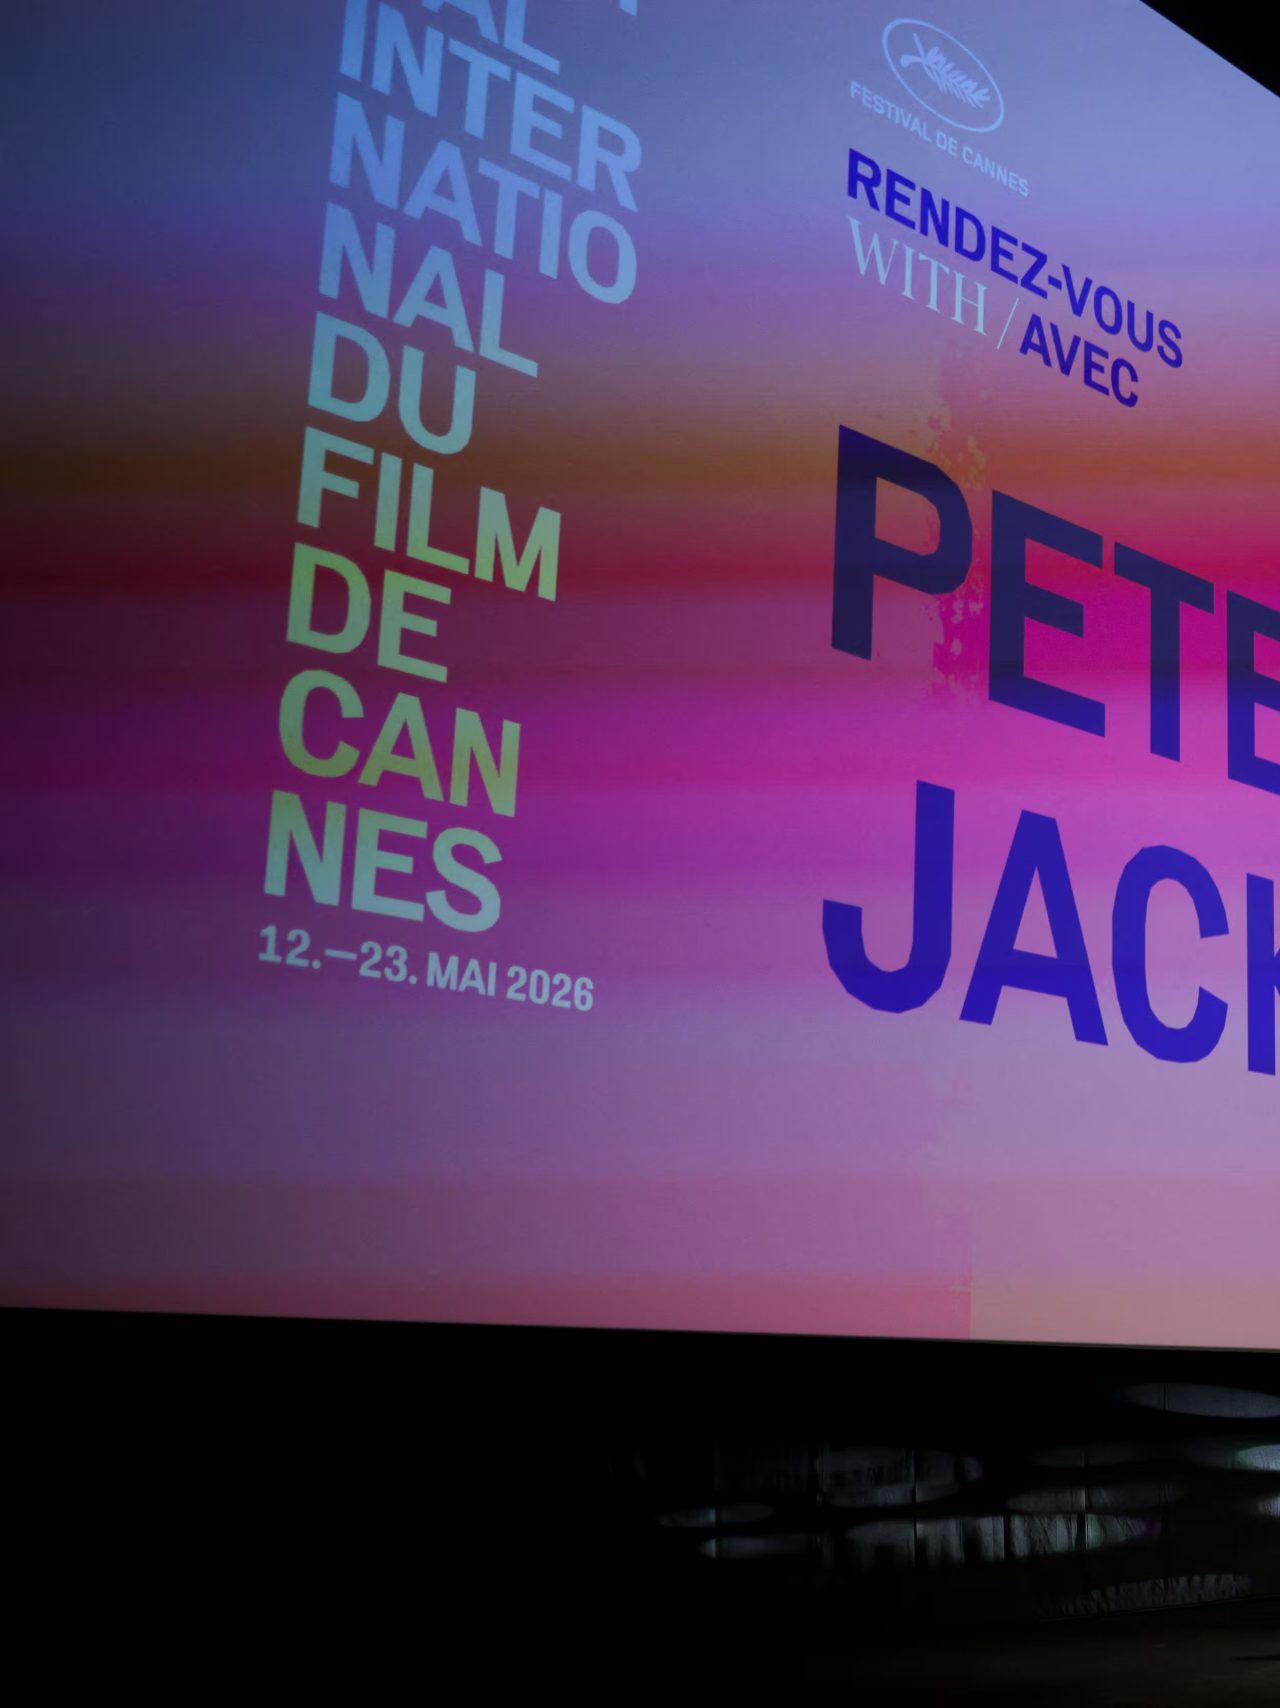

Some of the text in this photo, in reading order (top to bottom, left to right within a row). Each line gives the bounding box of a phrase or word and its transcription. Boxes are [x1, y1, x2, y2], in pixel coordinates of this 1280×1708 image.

[339, 0, 642, 212] INTER
[850, 80, 1029, 197] FESTIVAL DE CANNES
[329, 92, 637, 304] NATIO
[847, 147, 1184, 369] RENDEZ-VOUS
[319, 202, 538, 378] NAL
[847, 215, 1139, 408] WITH / AVEC
[308, 312, 476, 455] DU
[297, 427, 561, 602] FILM
[286, 543, 452, 683] DE
[279, 670, 521, 818] CAN
[263, 790, 503, 932] NES
[427, 952, 496, 996] MAI
[506, 966, 594, 1012] 2026
